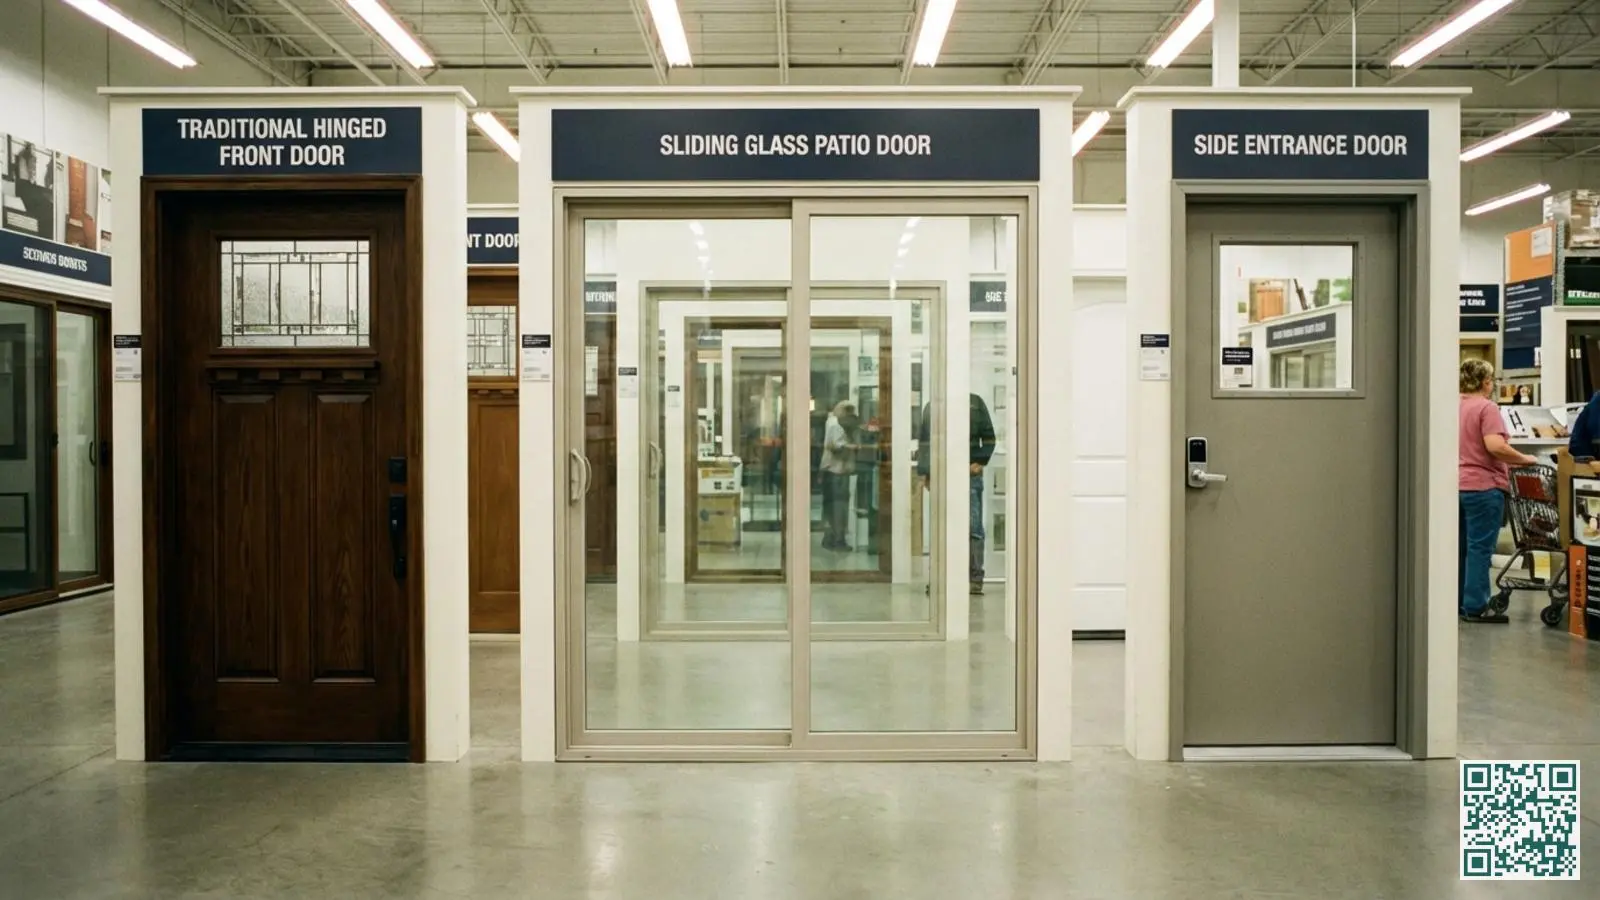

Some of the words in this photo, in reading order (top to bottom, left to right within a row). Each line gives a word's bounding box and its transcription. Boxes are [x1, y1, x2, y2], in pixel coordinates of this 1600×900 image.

[178, 118, 307, 139] TRADITIONAL
[313, 117, 387, 139] HINGED
[220, 144, 285, 166] FRONT
[291, 144, 345, 166] DOOR
[660, 134, 738, 156] SLIDING
[744, 134, 808, 156] GLASS
[815, 134, 870, 156] PATIO
[877, 134, 931, 156] DOOR
[1194, 134, 1238, 155] SIDE
[1244, 134, 1347, 155] ENTRANCE
[1353, 134, 1407, 155] DOOR
